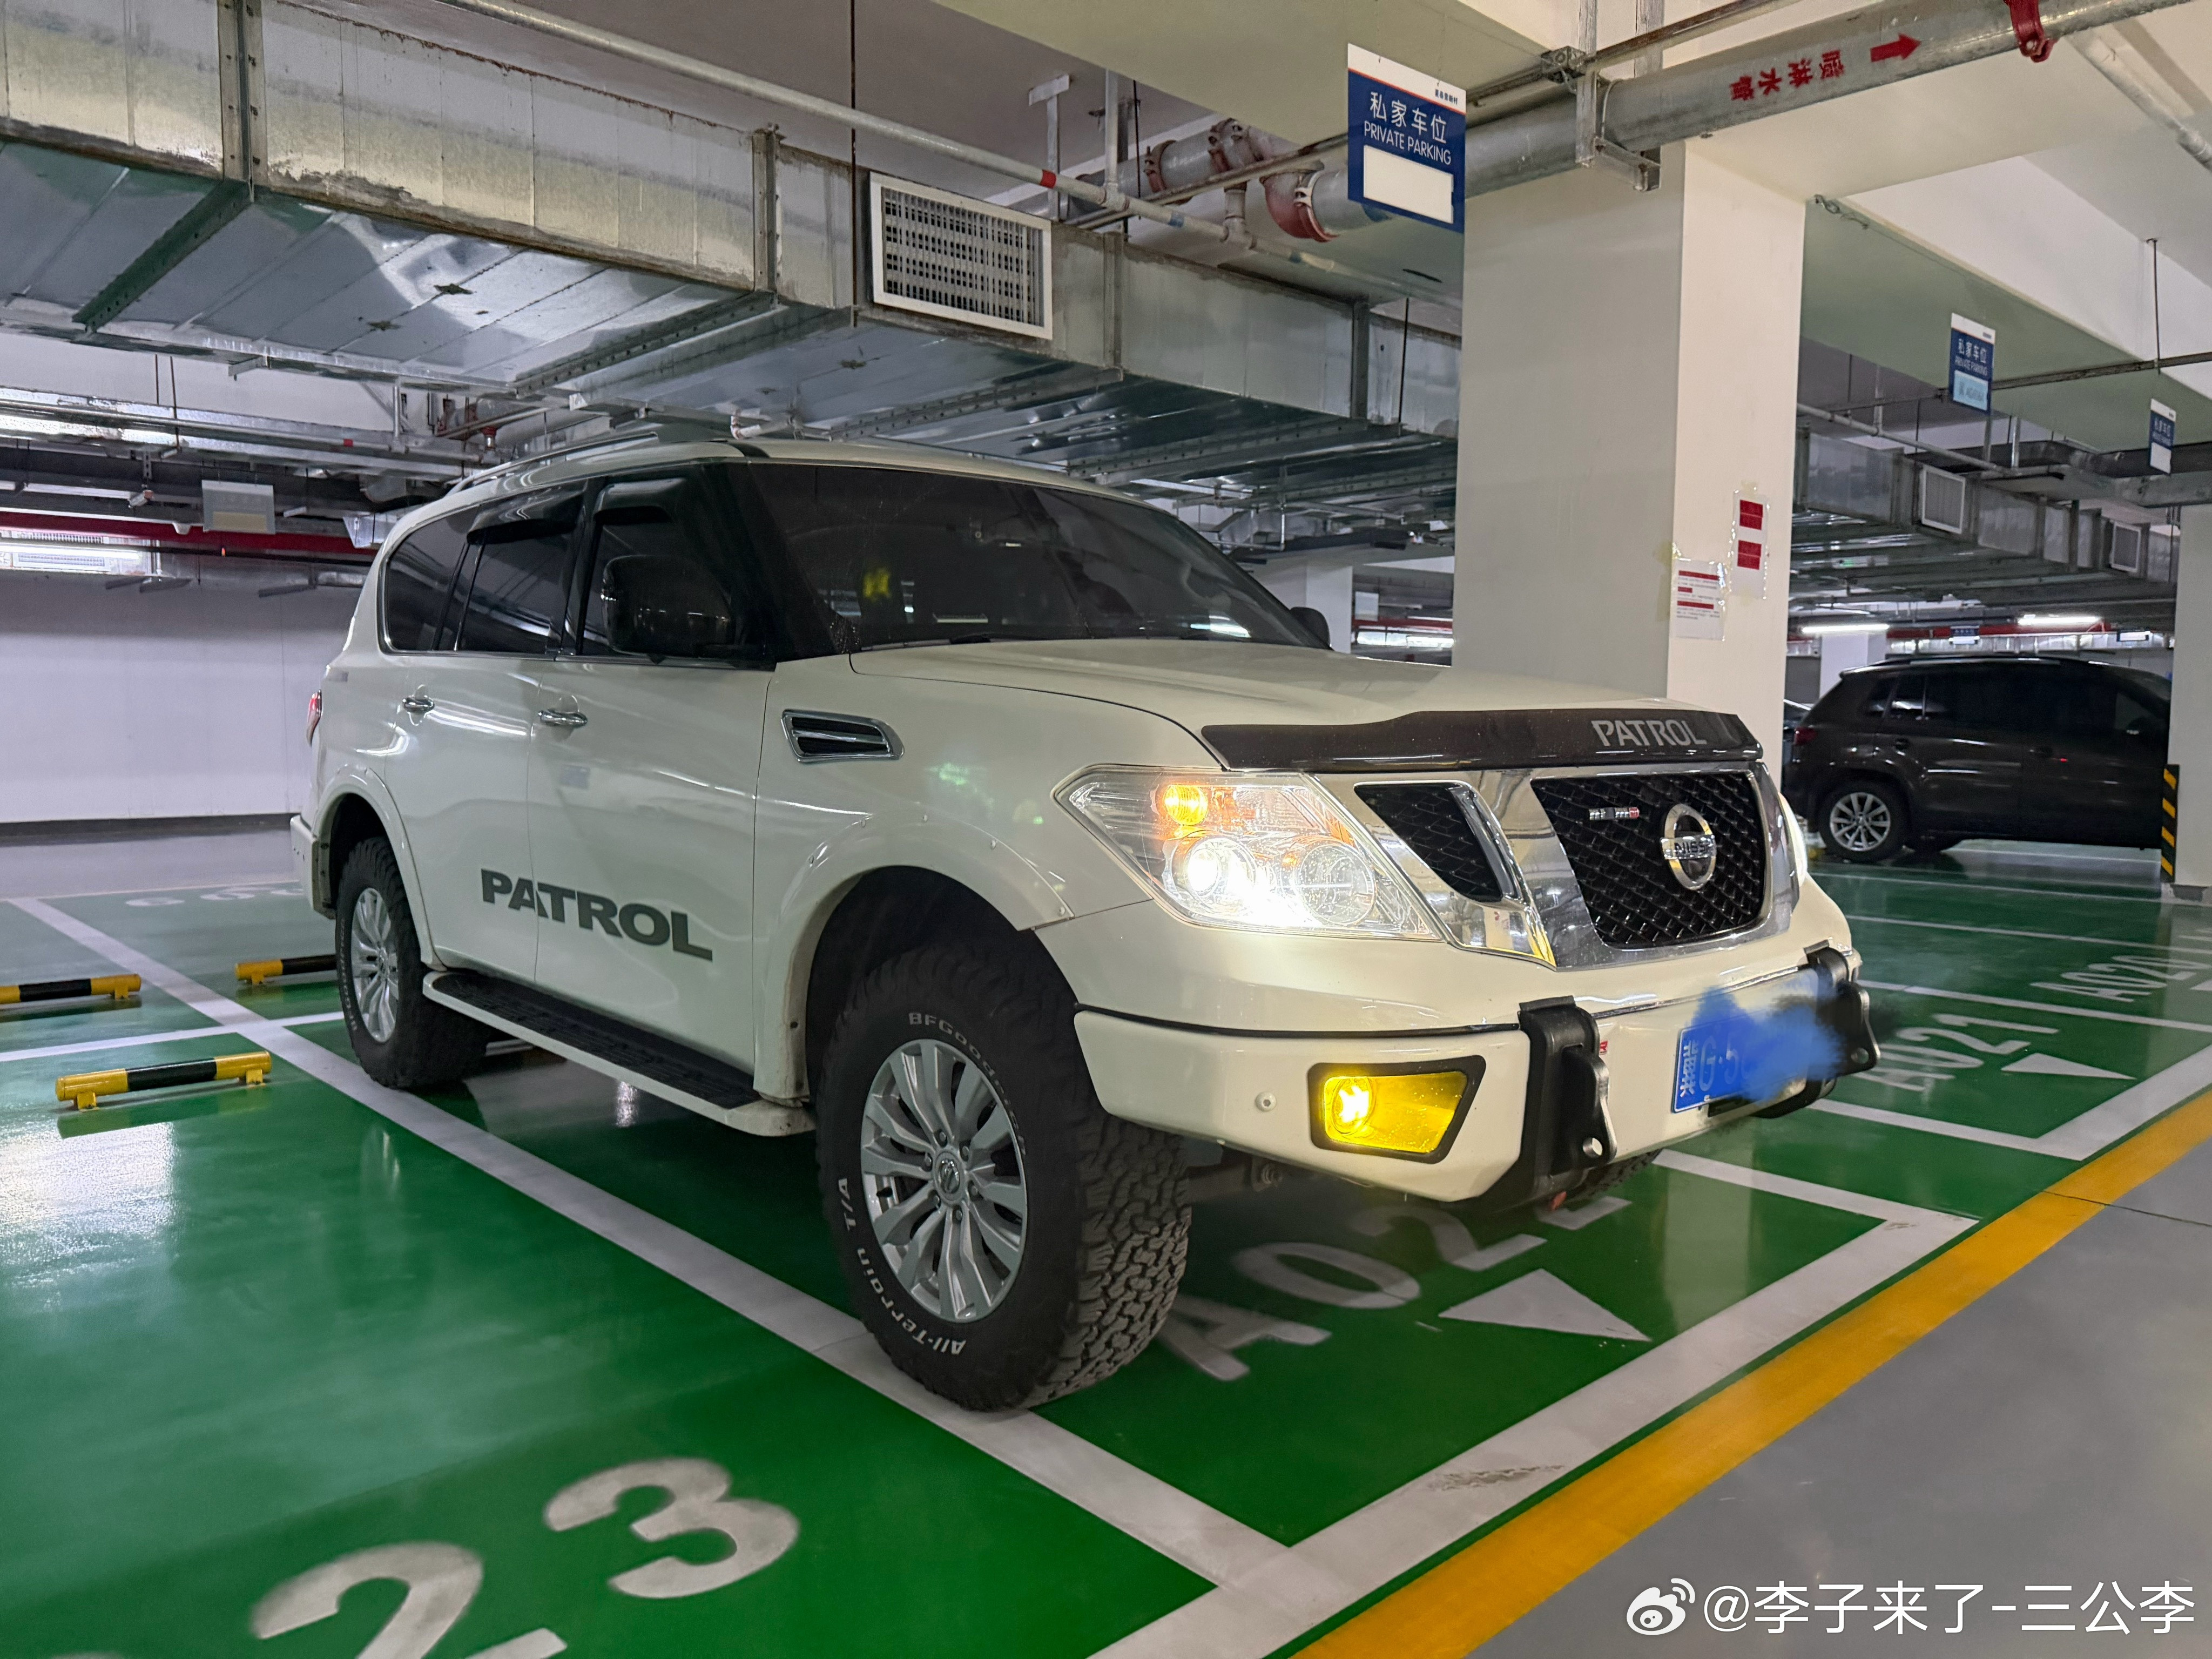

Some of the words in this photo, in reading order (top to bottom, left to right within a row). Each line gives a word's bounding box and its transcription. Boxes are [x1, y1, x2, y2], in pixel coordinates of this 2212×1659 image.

[1364, 120, 1404, 150] PRIVATE
[1407, 136, 1452, 165] PARKING
[1370, 91, 1446, 143] 私家车位
[1591, 720, 1707, 746] PATROL
[481, 869, 713, 962] PATROL
[2029, 955, 2212, 1003] A020
[838, 1178, 857, 1232] T/A
[249, 1456, 801, 1659] 23
